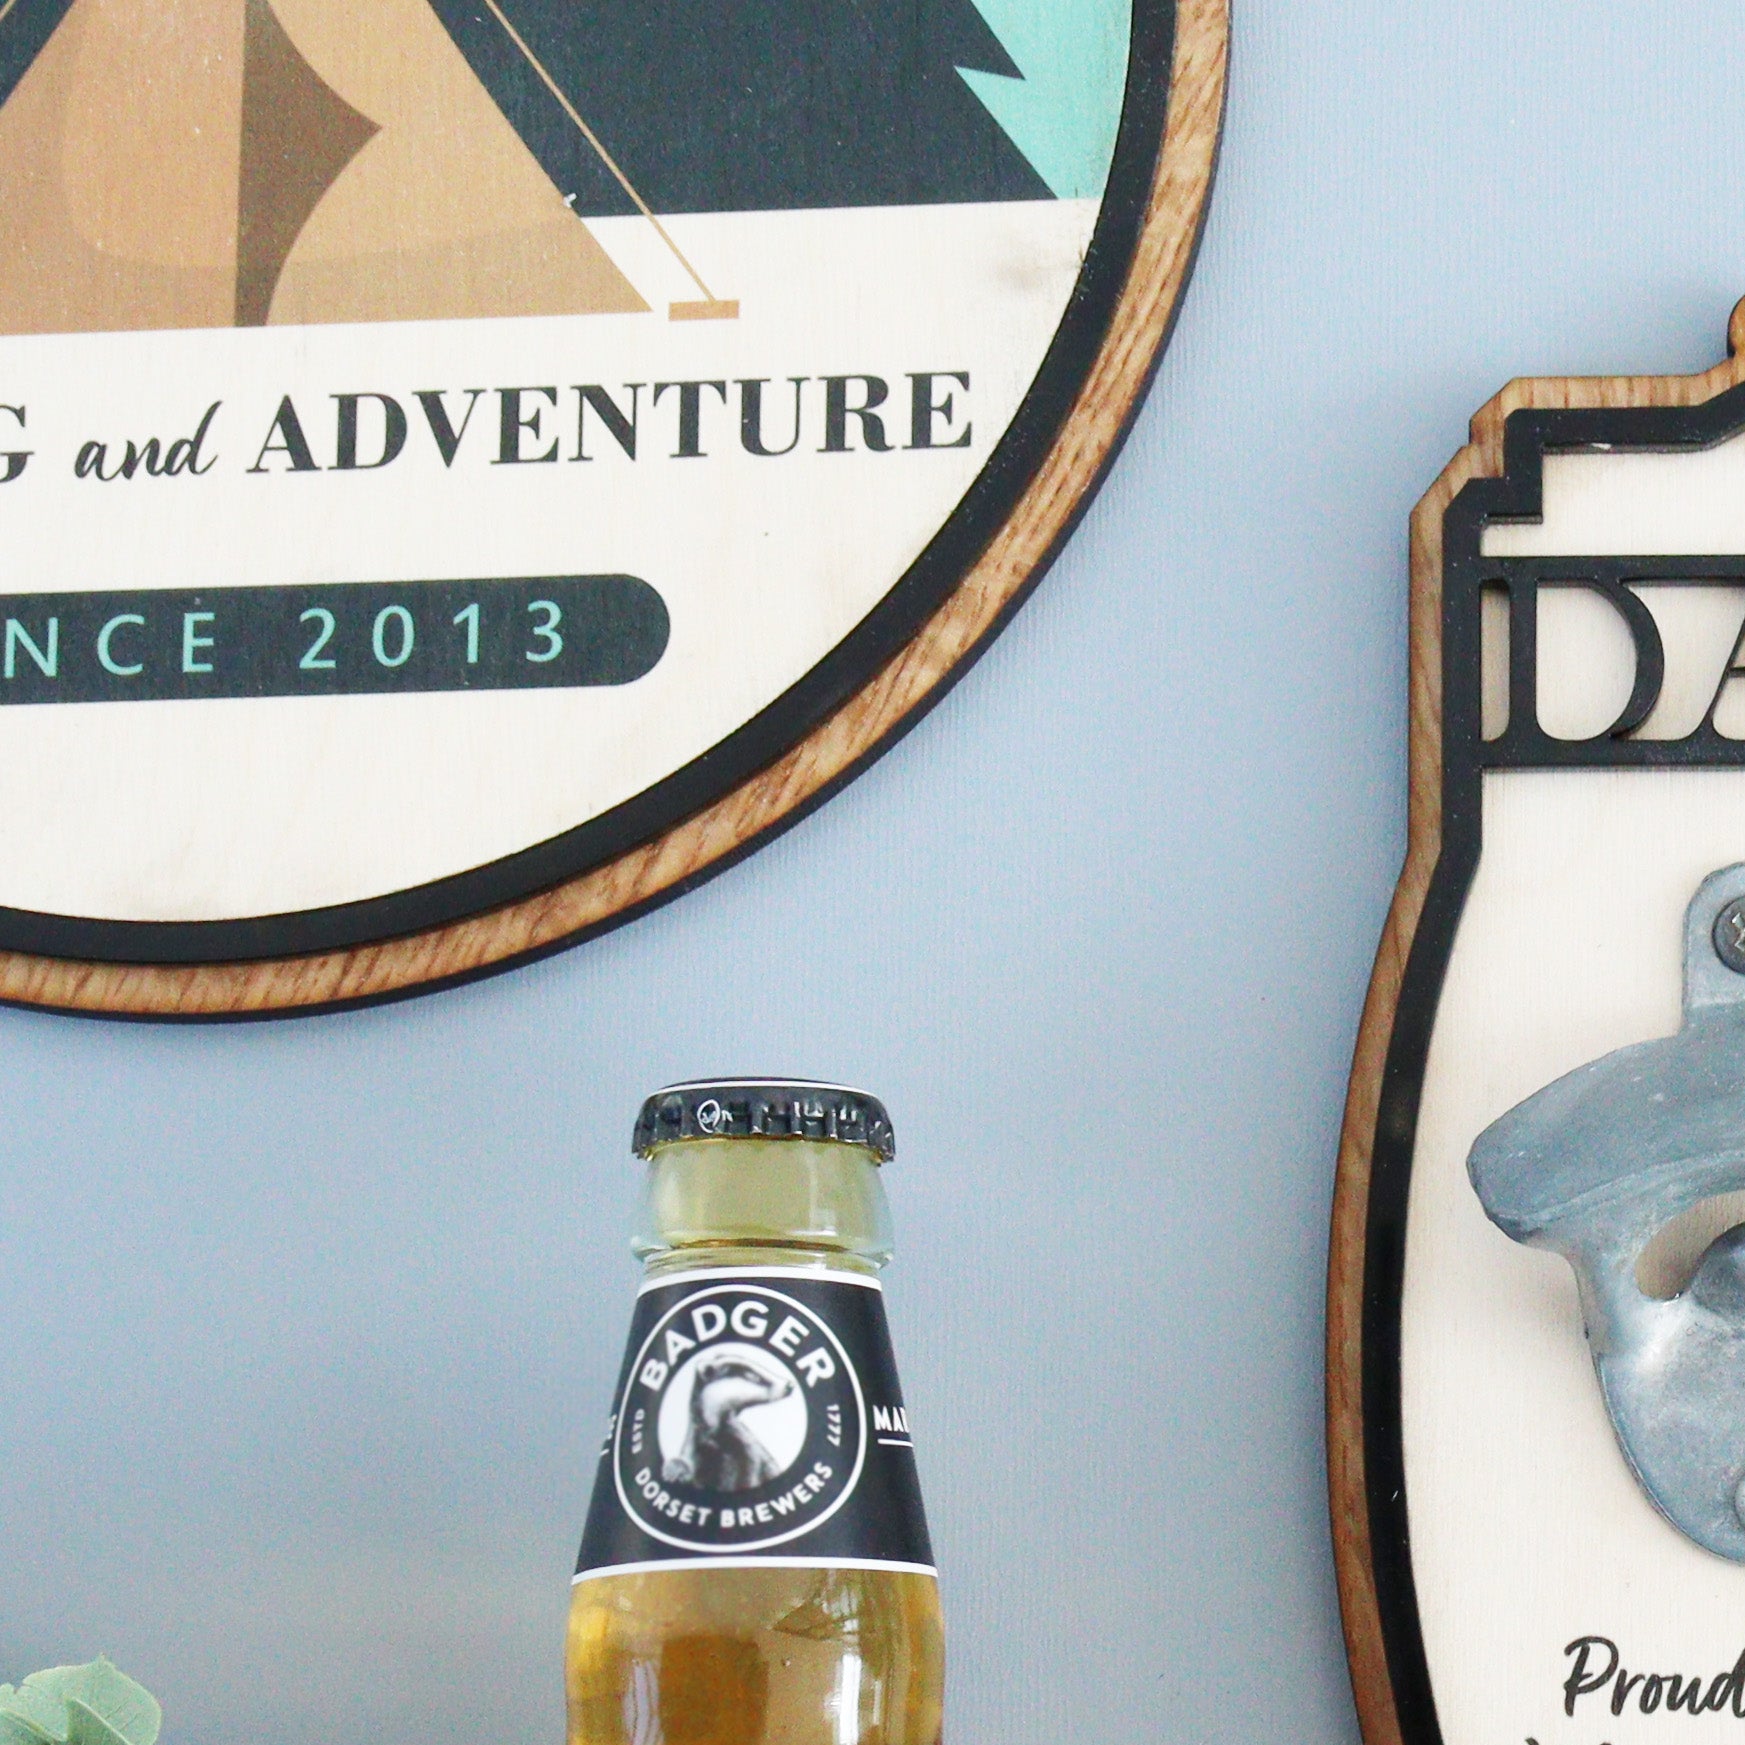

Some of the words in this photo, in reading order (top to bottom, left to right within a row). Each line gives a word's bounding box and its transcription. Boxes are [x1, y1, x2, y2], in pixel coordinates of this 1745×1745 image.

[73, 399, 224, 482] and
[245, 370, 975, 475] ADVENTURE
[3, 611, 216, 679] NCE
[298, 599, 564, 670] 2013
[639, 1299, 837, 1393] BADGER
[826, 1403, 842, 1448] 1777
[633, 1465, 713, 1528] DORSET
[720, 1460, 833, 1529] BREWERS
